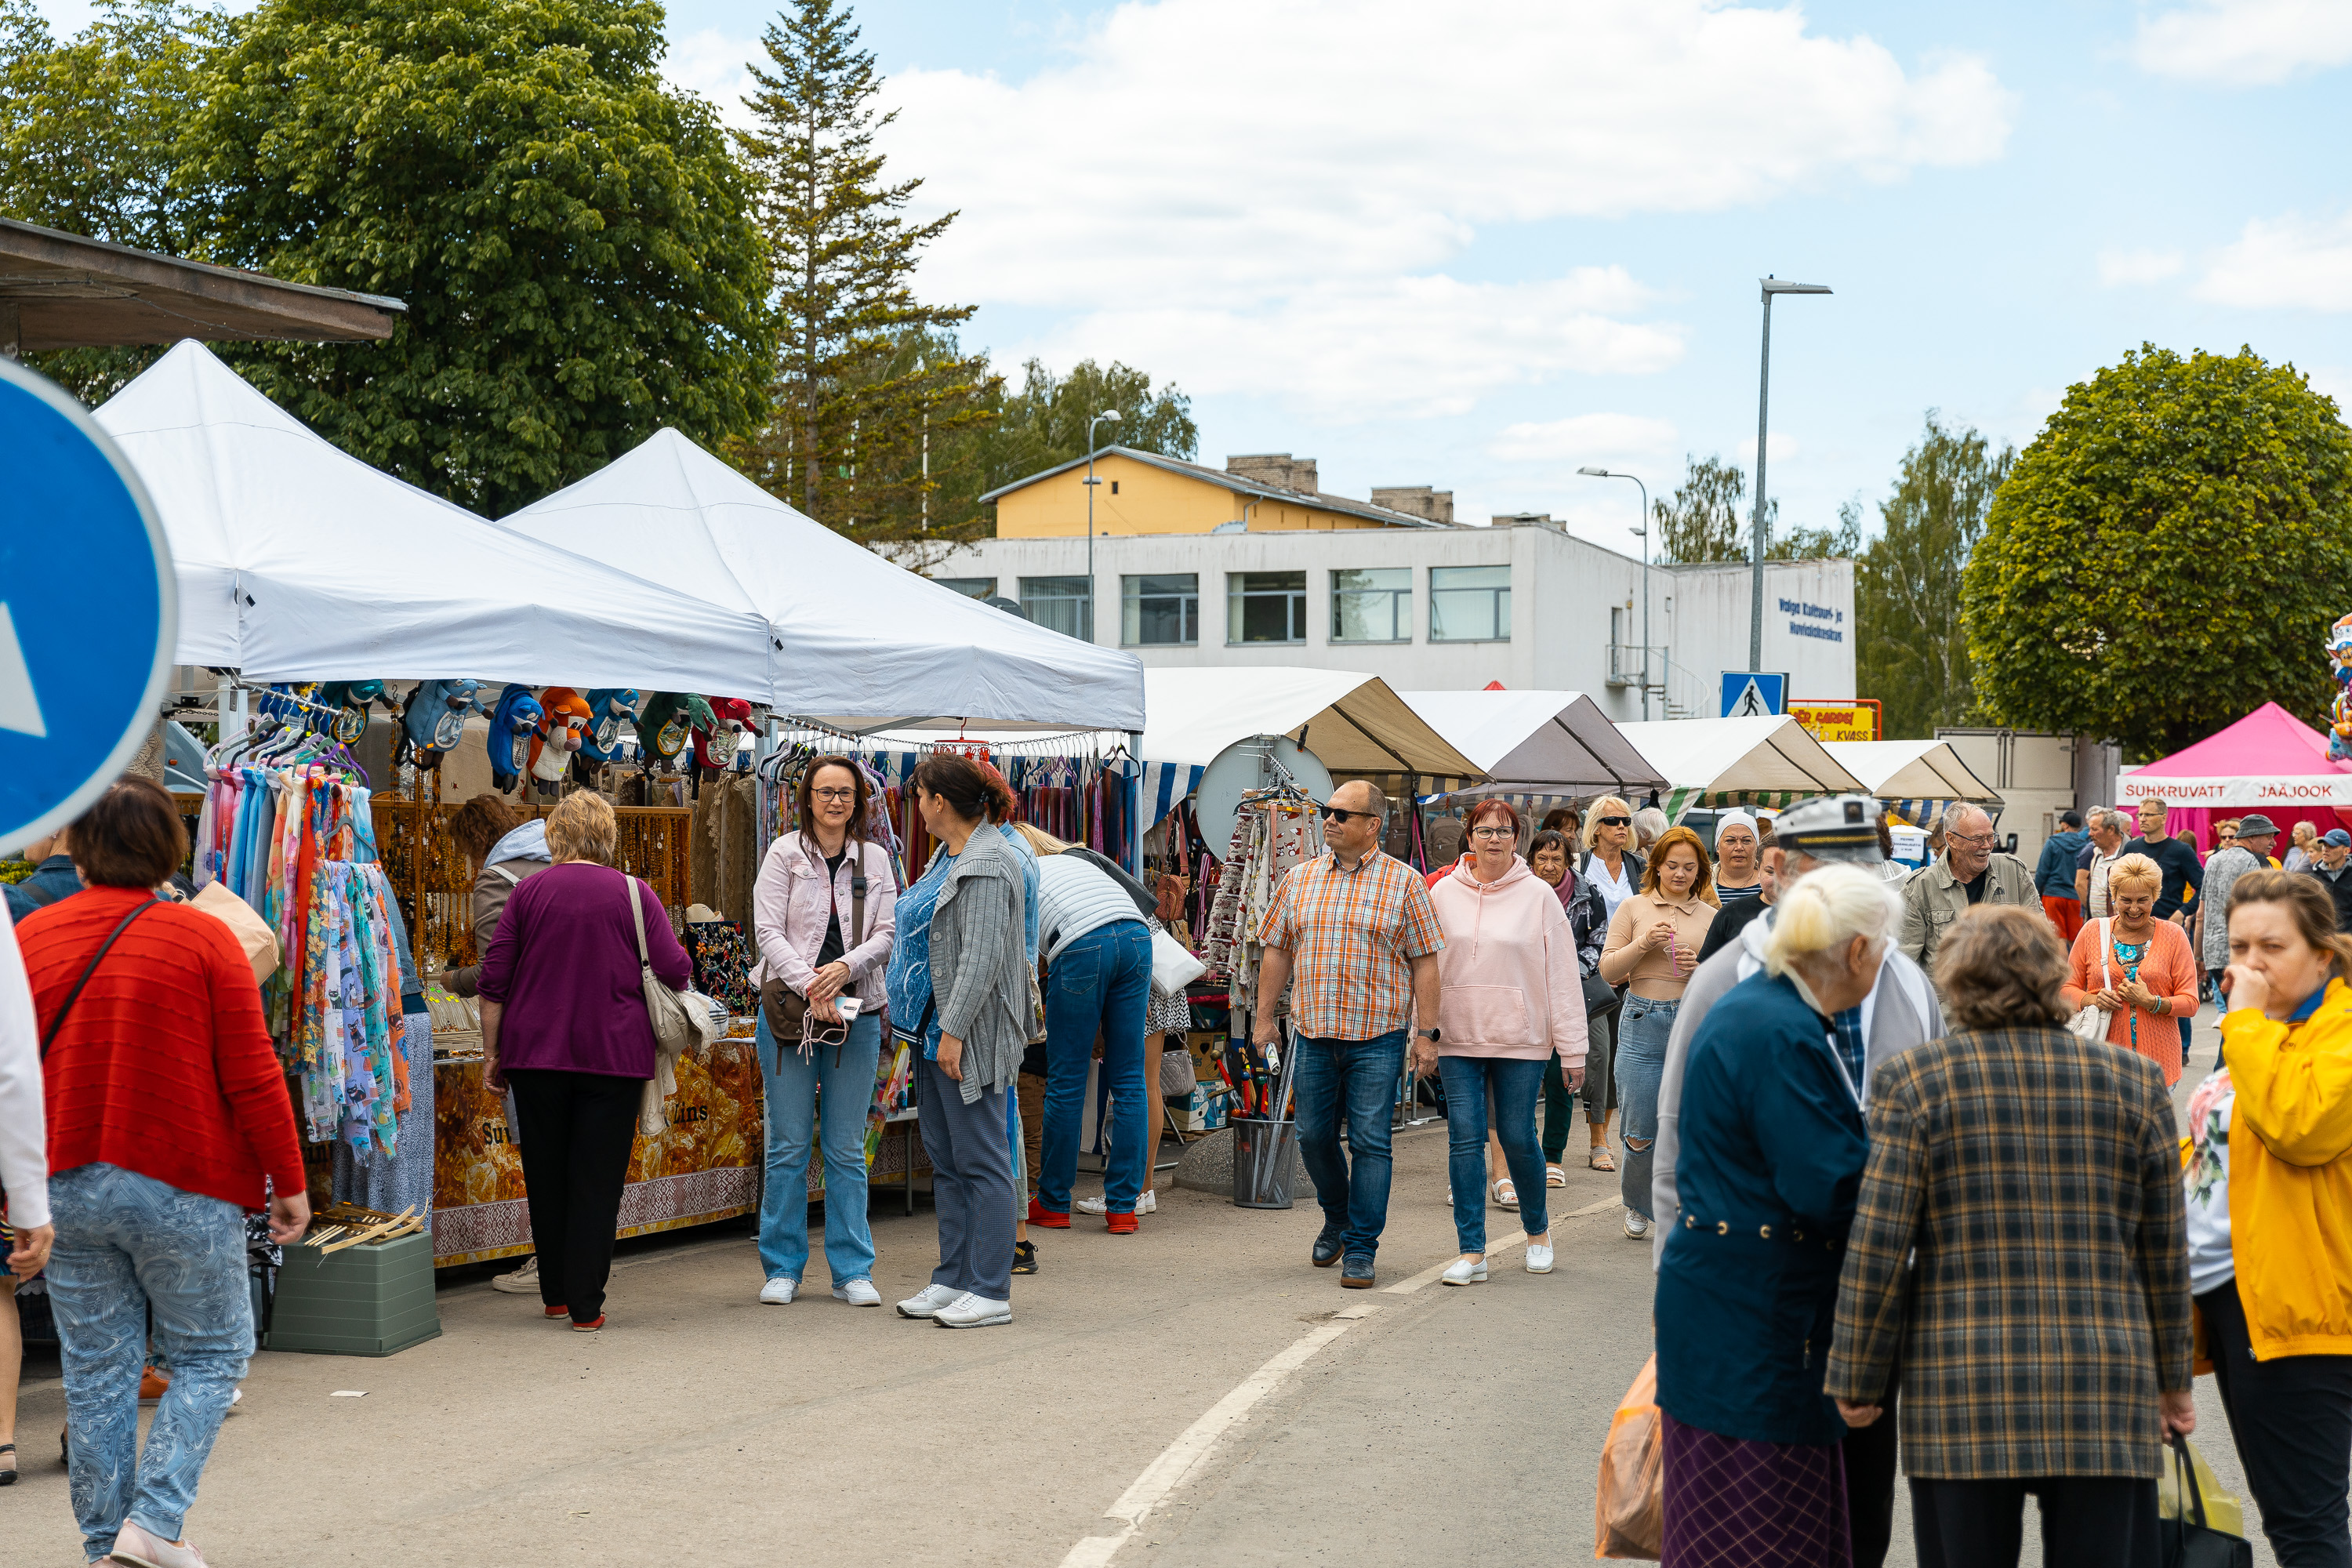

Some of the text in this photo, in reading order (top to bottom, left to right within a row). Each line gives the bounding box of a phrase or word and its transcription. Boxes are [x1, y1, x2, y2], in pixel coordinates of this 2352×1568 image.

[1836, 730, 1869, 742] KVASS
[2125, 782, 2333, 798] SUHKRUVATT JÄÄJOOK
[673, 1101, 708, 1125] Lins
